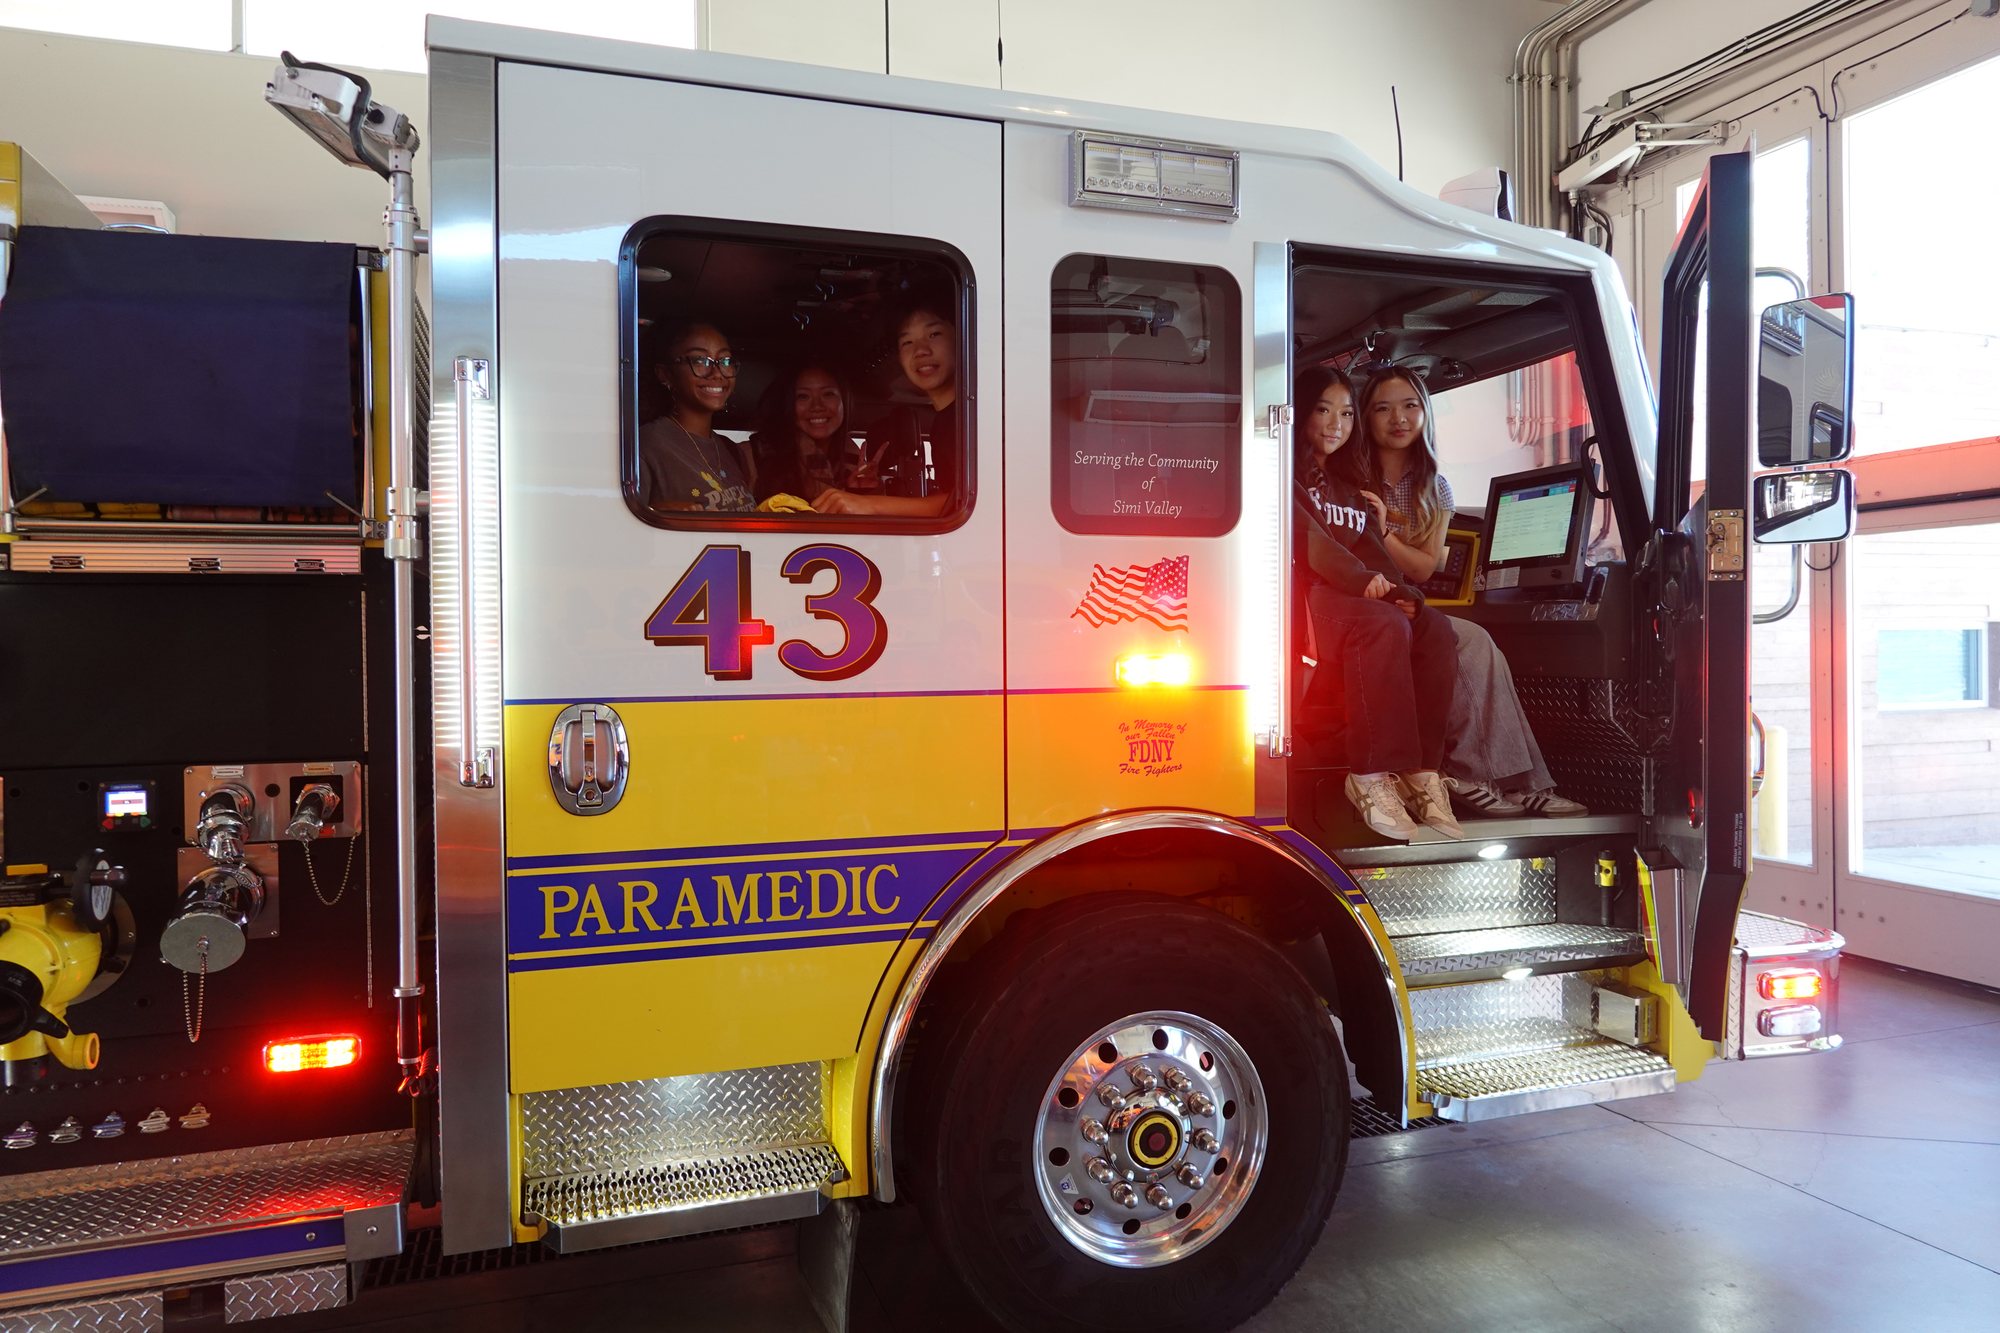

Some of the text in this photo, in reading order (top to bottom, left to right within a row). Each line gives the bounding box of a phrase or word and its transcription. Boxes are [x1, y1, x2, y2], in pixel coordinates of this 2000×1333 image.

[1074, 450, 1219, 474] Serving the Community
[1141, 476, 1156, 492] of
[1113, 499, 1182, 519] Simi Valley
[644, 543, 889, 681] 43
[1119, 719, 1187, 735] In Memory of
[1126, 728, 1175, 741] our Fallen
[1129, 739, 1174, 763] FDNY
[1119, 763, 1182, 777] Fire Fighters
[538, 864, 901, 940] PARAMEDIC
